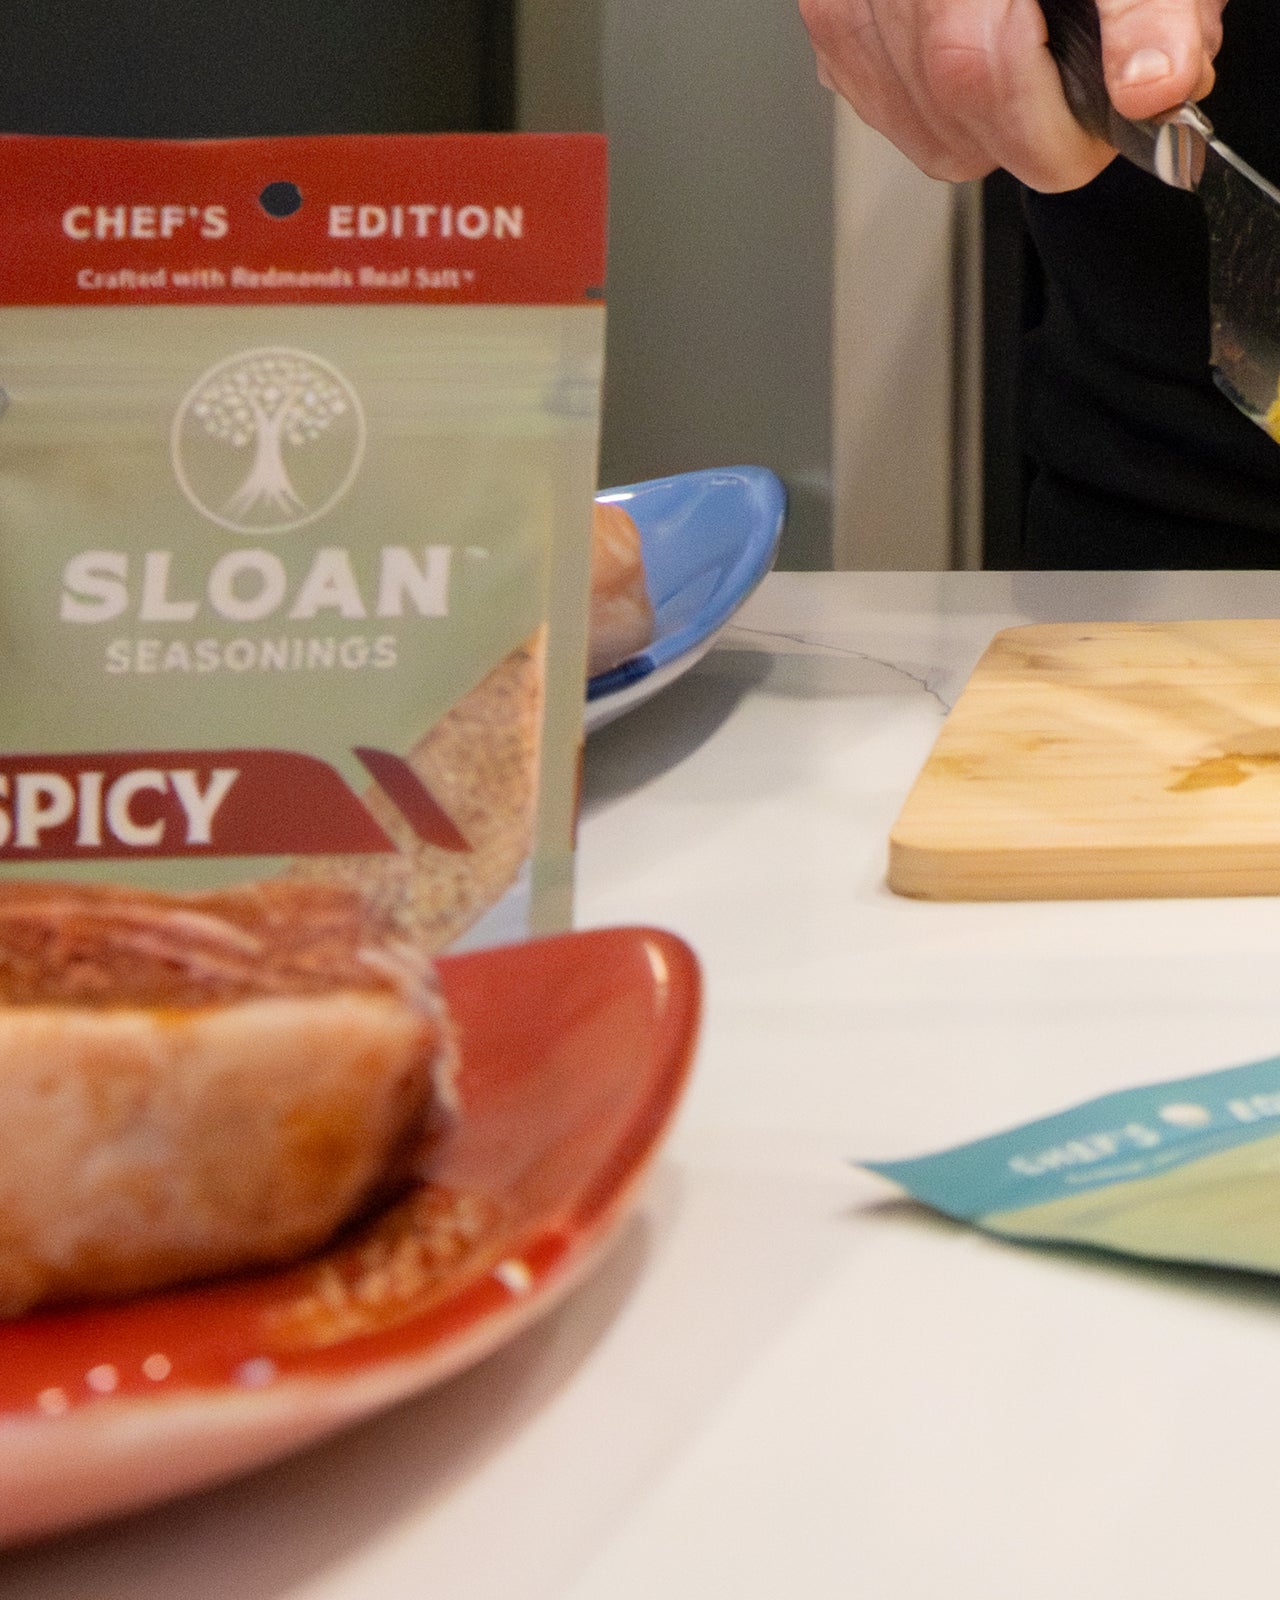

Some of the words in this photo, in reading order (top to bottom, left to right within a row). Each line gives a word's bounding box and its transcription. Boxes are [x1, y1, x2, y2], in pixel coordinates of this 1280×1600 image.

[61, 204, 231, 240] CHEF'S
[326, 204, 525, 240] EDITION
[59, 542, 451, 625] SLOAN
[104, 634, 400, 676] SEASONINGS
[0, 767, 243, 850] PICY
